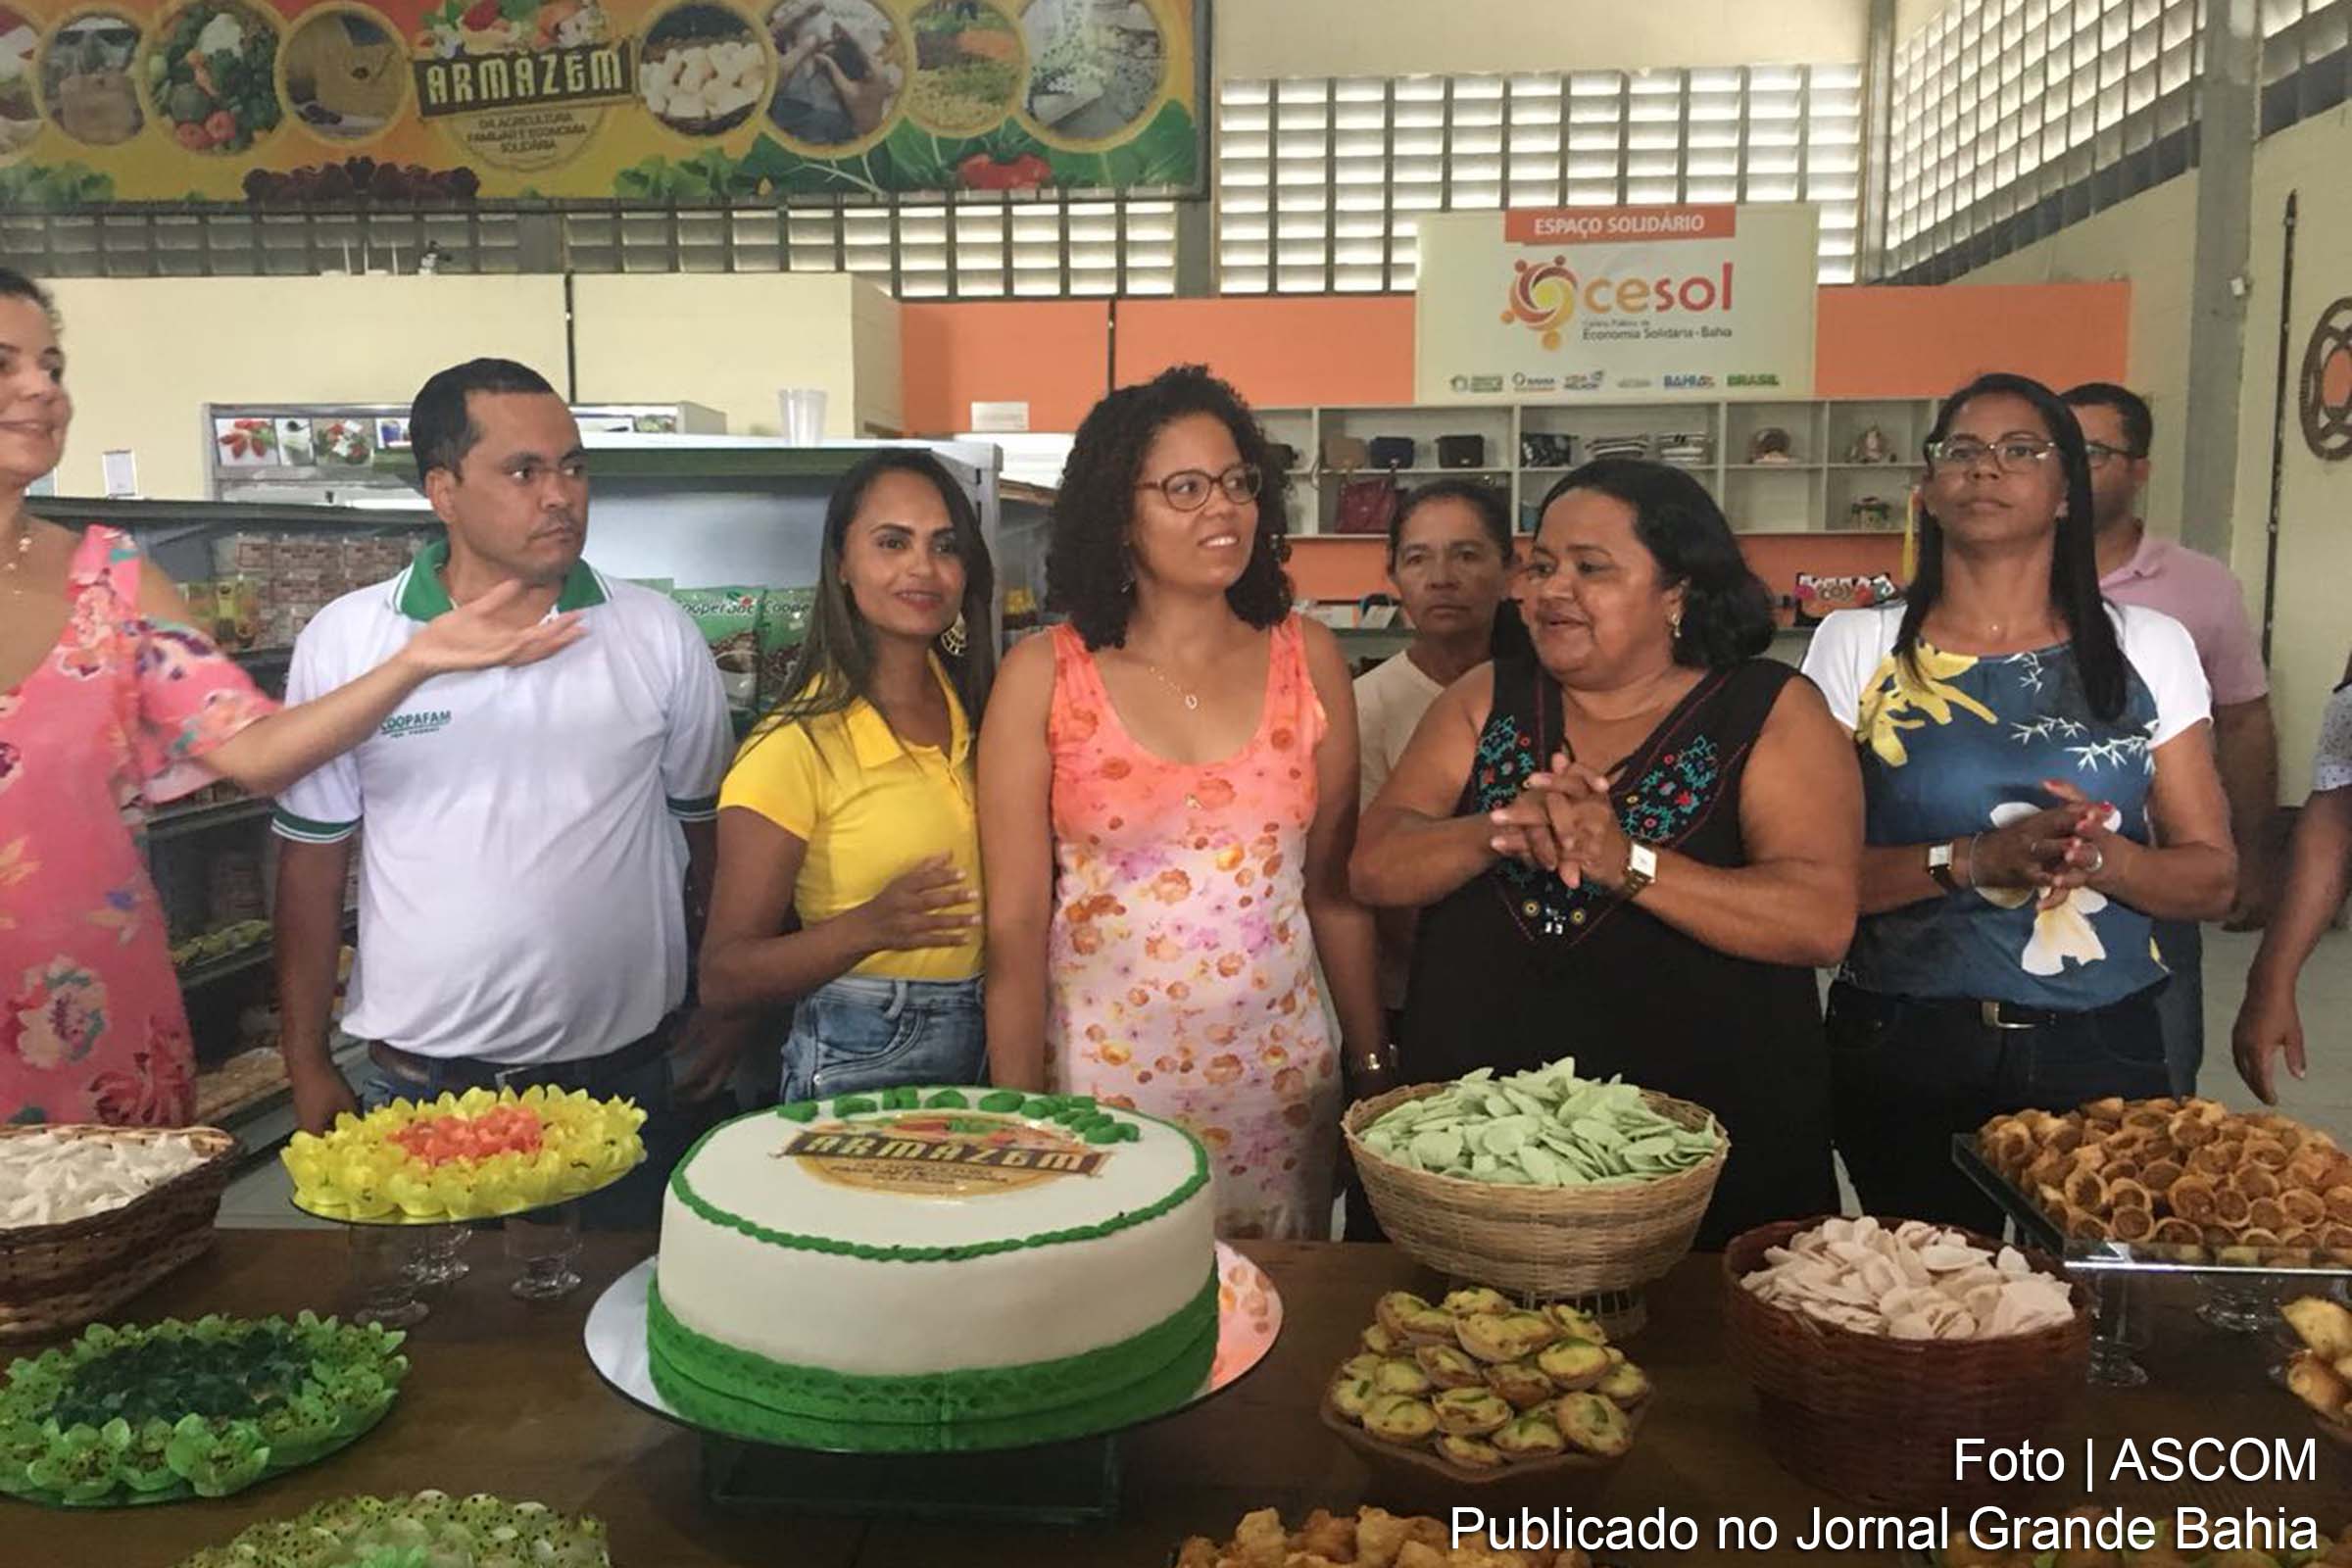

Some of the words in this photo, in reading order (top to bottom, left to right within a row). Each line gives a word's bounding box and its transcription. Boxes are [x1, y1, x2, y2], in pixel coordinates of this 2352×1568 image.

[1534, 217, 1602, 239] ESPAÇO
[1606, 212, 1705, 234] SOLIDÁRIO
[1584, 262, 1734, 314] cesol
[1583, 327, 1641, 341] Economia
[1727, 373, 1780, 386] BRASIL
